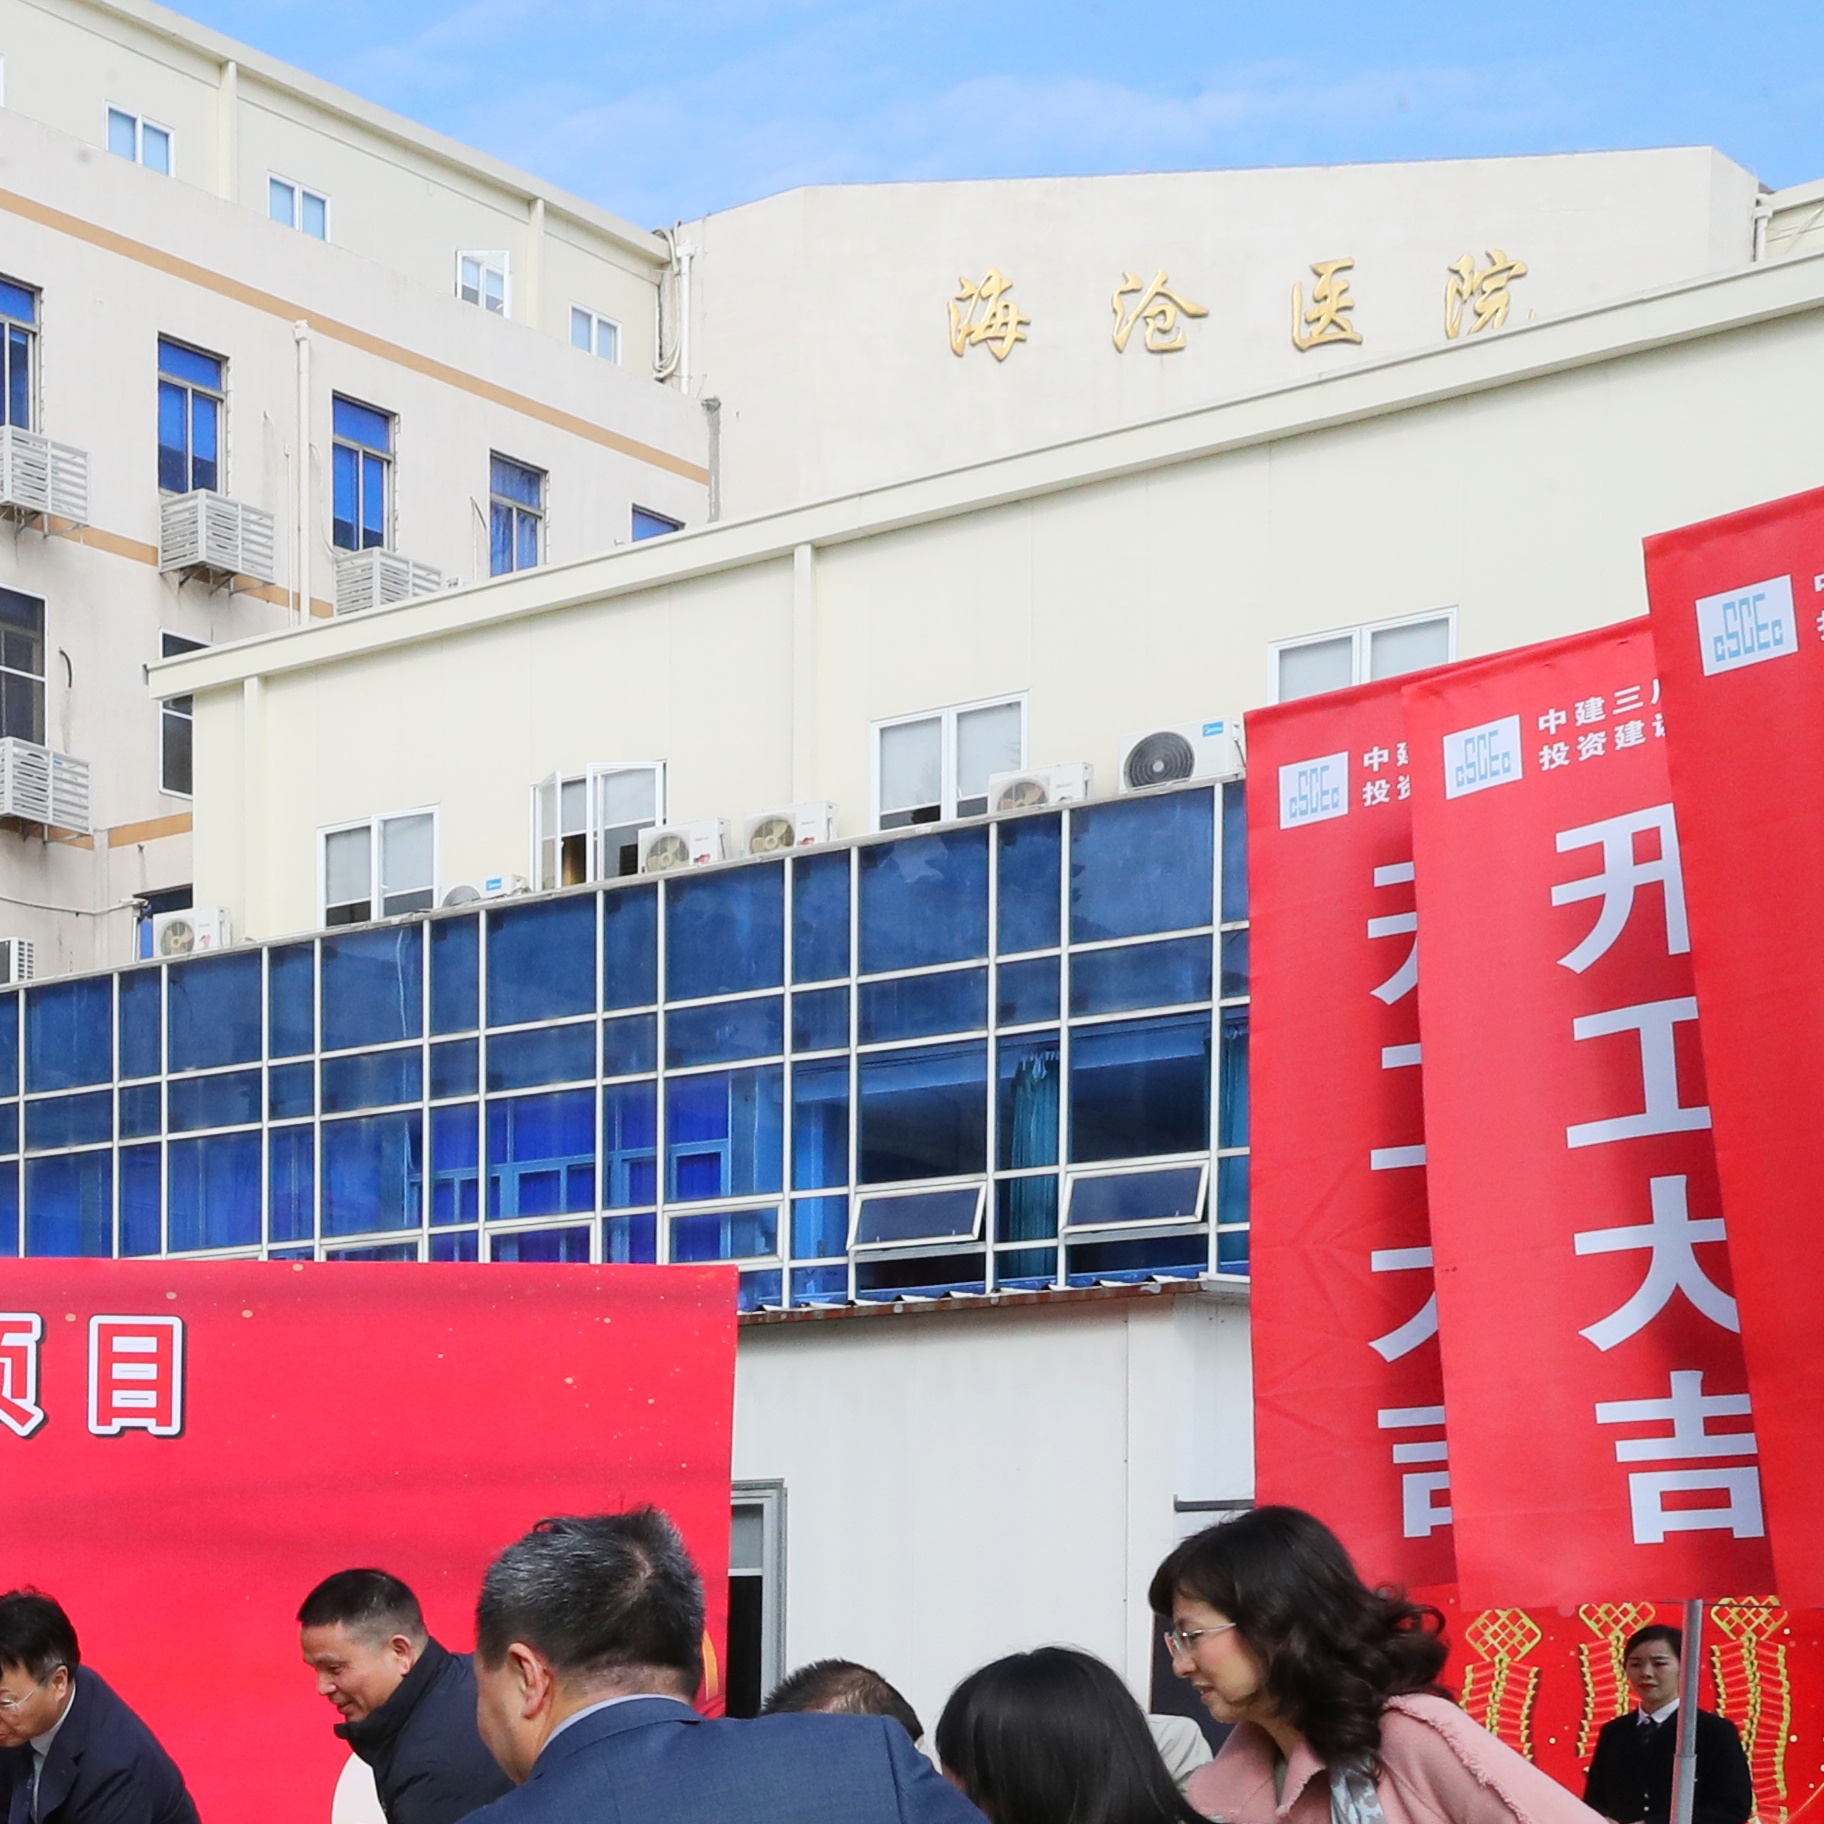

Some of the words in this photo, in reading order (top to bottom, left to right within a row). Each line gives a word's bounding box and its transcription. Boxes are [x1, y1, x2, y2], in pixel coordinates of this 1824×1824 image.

[948, 249, 1536, 362] 海沧医院
[1538, 678, 1661, 735] 中建三
[1549, 802, 1766, 1545] 开工大吉
